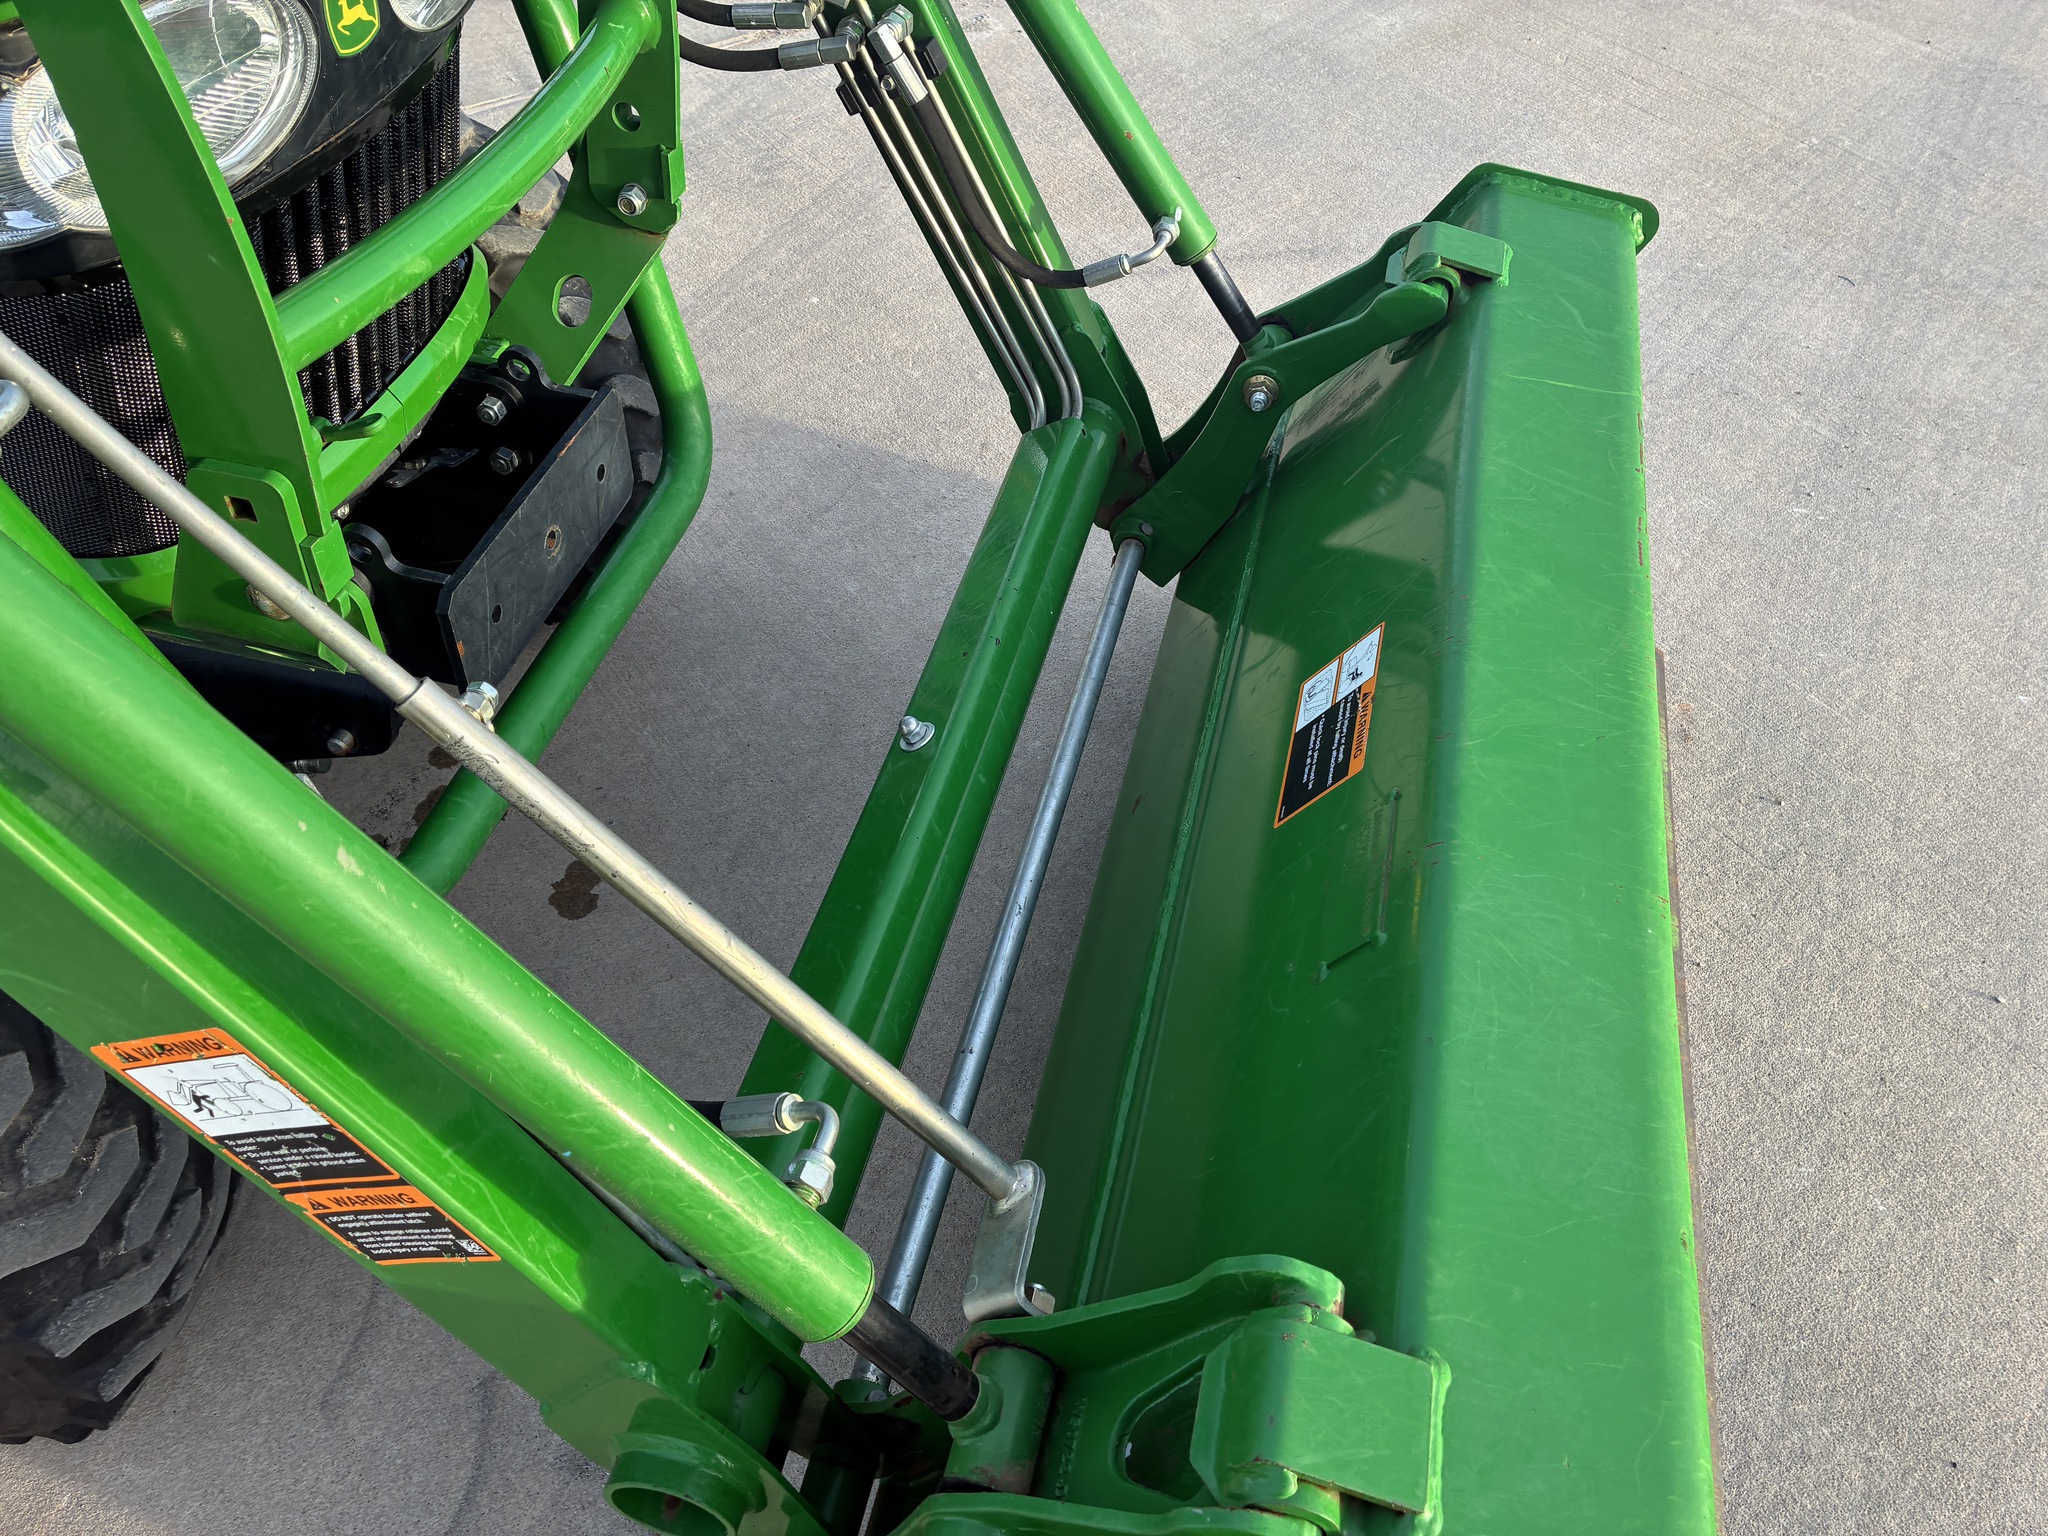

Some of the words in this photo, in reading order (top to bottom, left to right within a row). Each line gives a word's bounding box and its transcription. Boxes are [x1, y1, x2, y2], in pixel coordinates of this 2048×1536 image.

[1317, 718, 1325, 737] Quick
[1341, 718, 1349, 736] injury
[1354, 701, 1369, 759] WARNING
[1332, 729, 1341, 750] falling
[132, 1038, 222, 1059] WARNING
[319, 1159, 346, 1167] ground
[327, 1193, 418, 1207] WARNING
